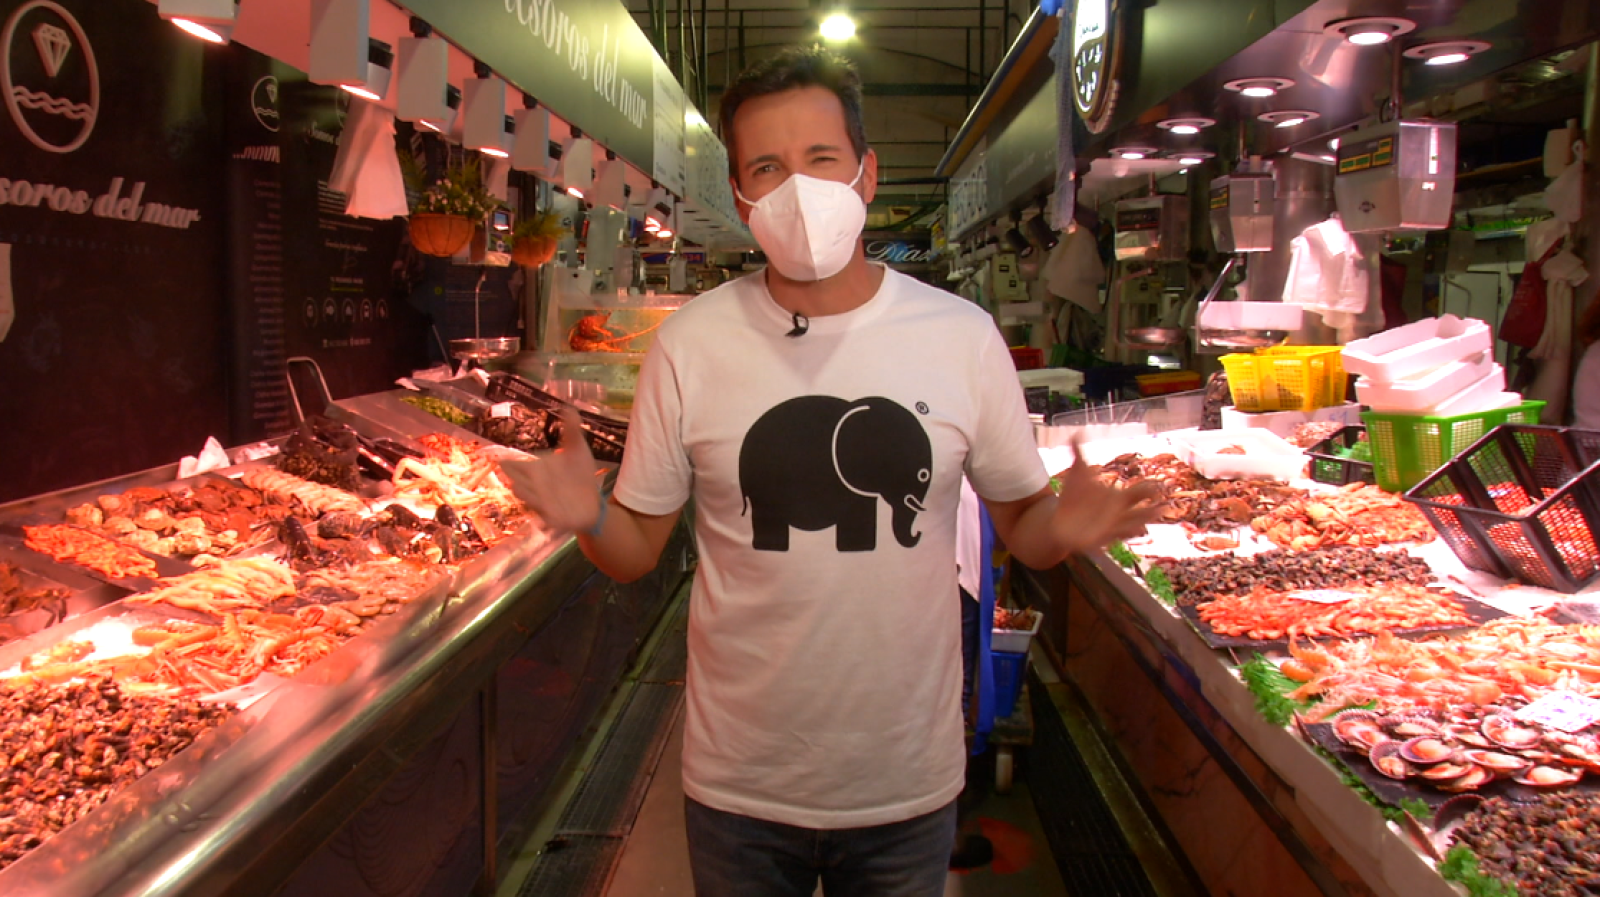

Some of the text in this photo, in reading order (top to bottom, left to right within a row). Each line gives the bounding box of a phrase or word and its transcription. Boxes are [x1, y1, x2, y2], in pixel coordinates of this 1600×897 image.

[594, 23, 620, 107] del
[620, 78, 647, 129] mar
[93, 177, 144, 221] del
[141, 202, 201, 228] mar
